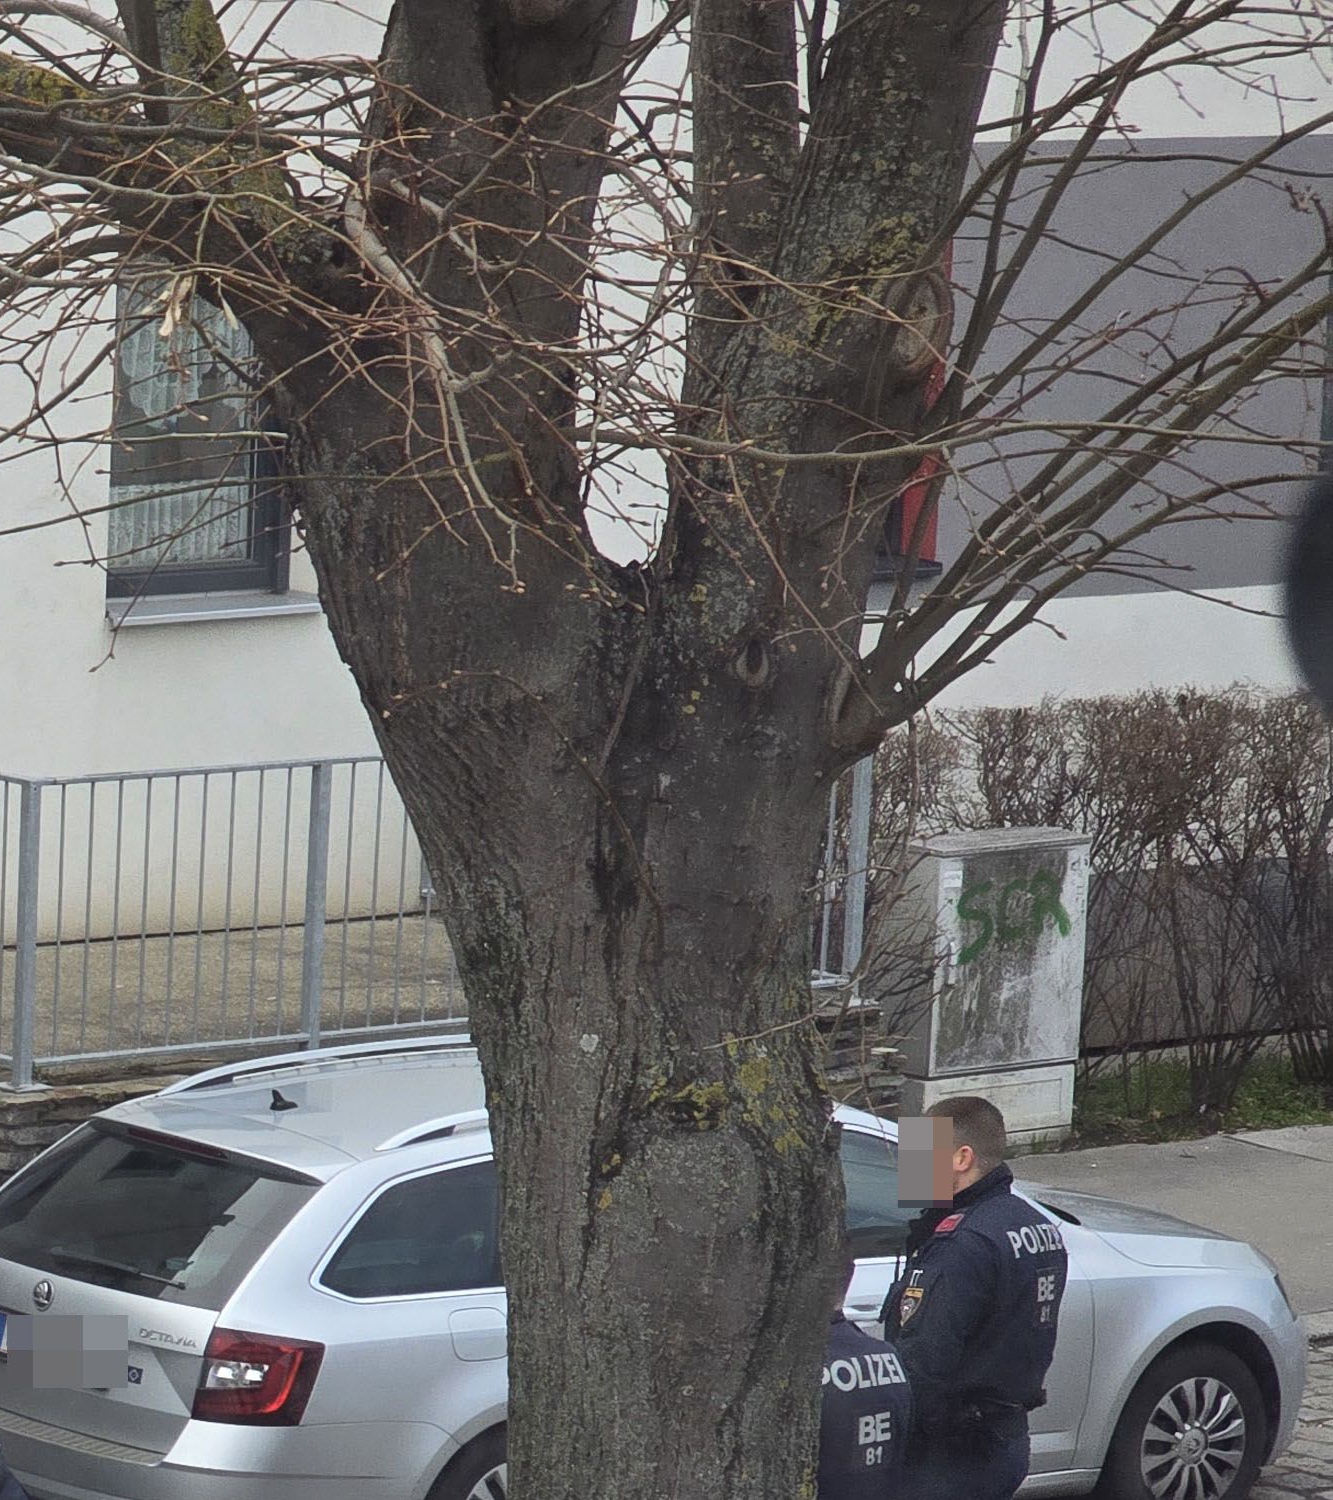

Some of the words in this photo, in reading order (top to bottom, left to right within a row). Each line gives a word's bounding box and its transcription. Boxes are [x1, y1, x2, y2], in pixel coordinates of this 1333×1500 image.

[1006, 1224, 1062, 1258] POLIZE
[1037, 1274, 1054, 1302] BE
[140, 1328, 196, 1348] OCTAVIA
[859, 1411, 891, 1445] BE
[866, 1446, 882, 1465] 81
